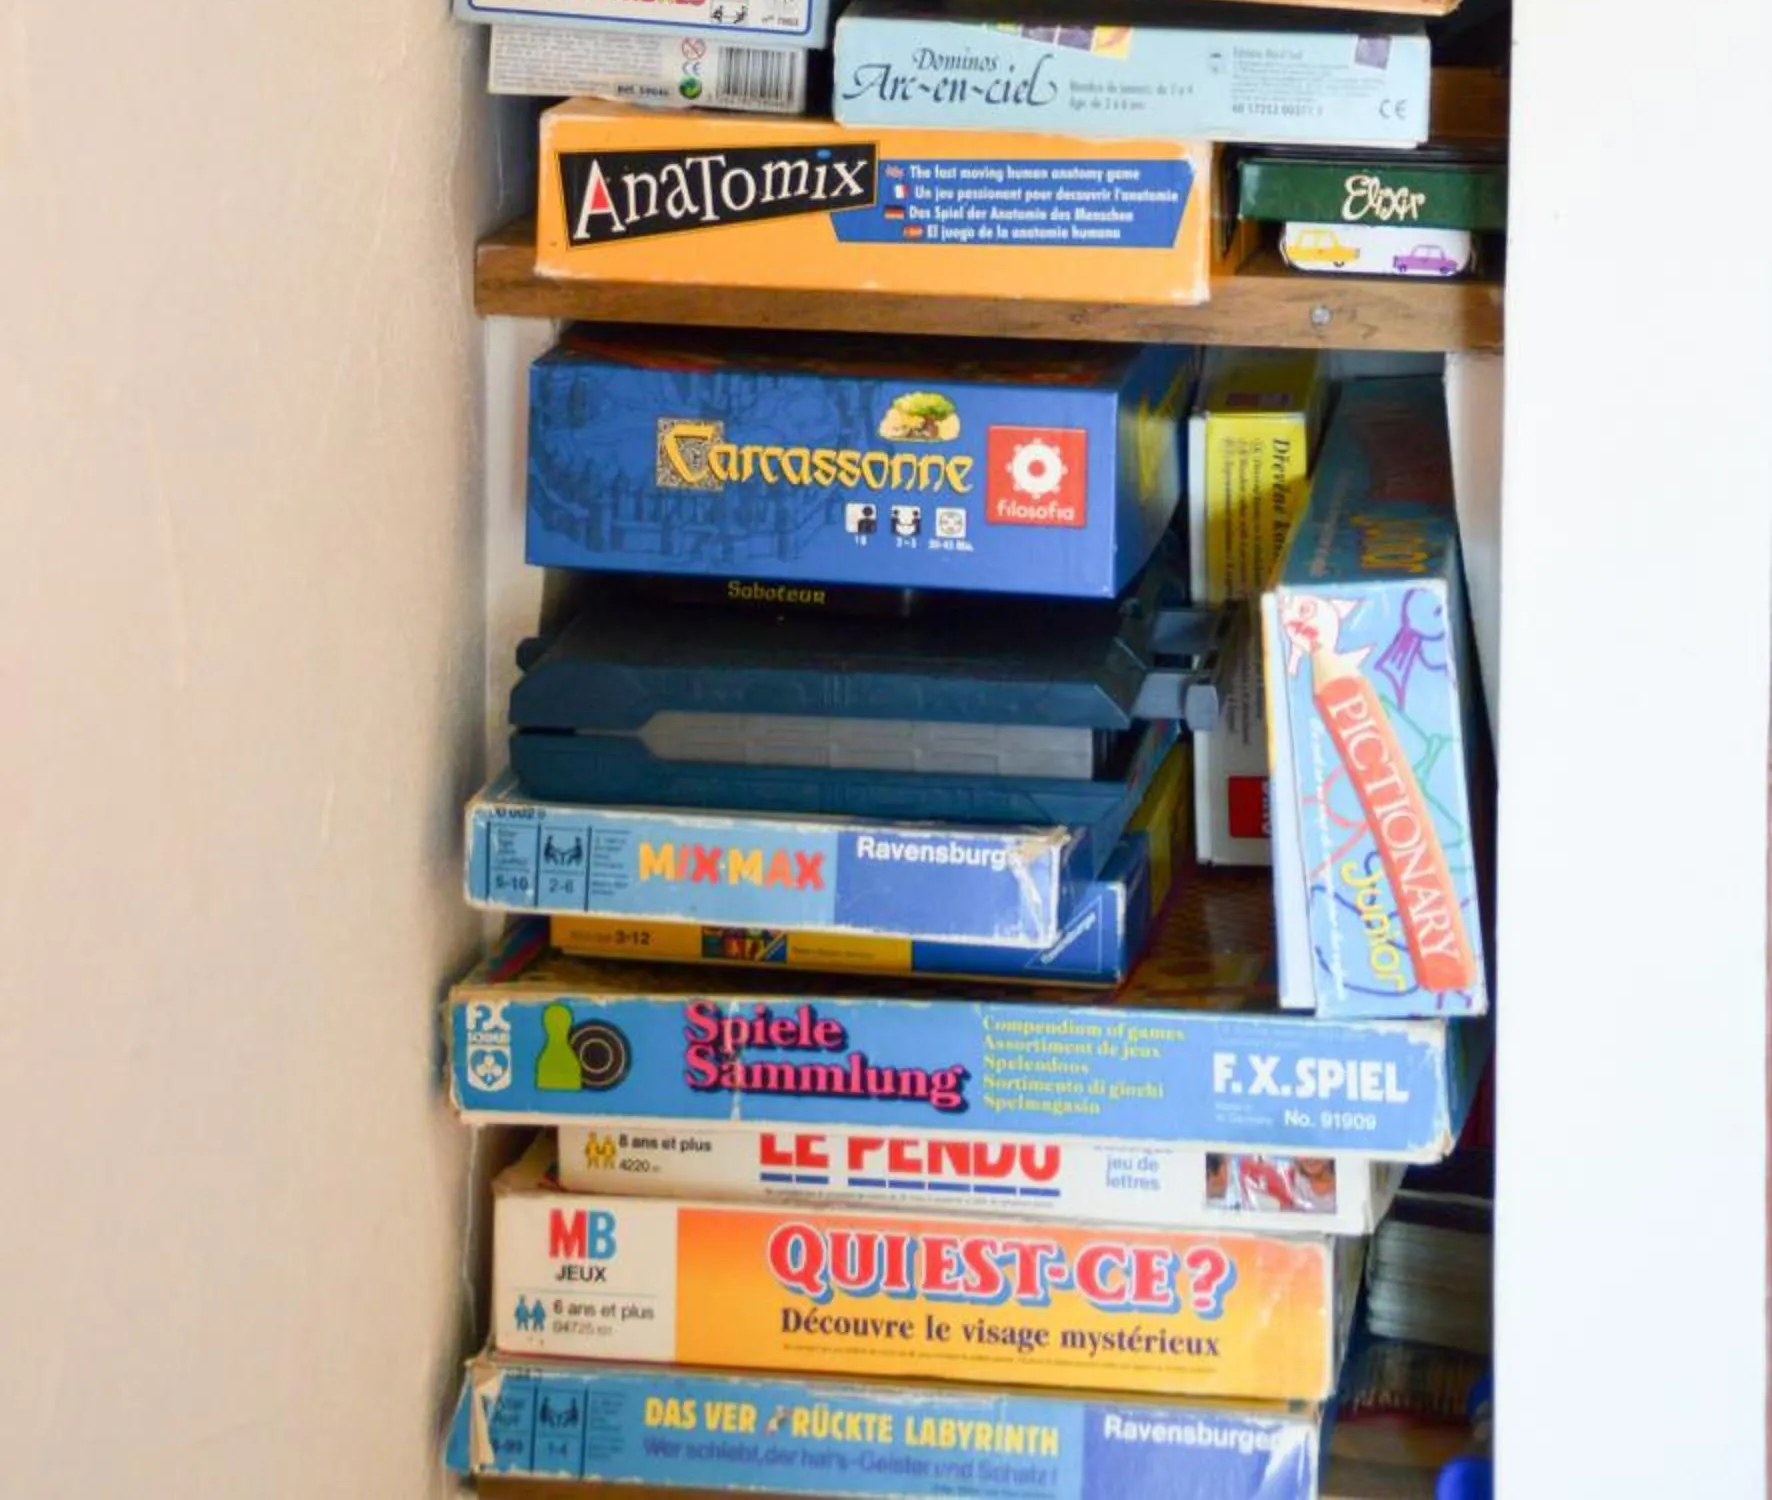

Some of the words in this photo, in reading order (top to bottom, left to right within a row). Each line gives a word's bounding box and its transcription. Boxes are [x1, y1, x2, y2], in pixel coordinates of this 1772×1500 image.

[911, 46, 1000, 73] Dominos
[841, 53, 1058, 107] Arc-en-ciel
[909, 164, 933, 180] The
[934, 164, 958, 180] fast
[959, 165, 1005, 184] moving
[1007, 165, 1048, 181] human
[1050, 167, 1104, 185] anatomy
[1105, 169, 1141, 185] game
[914, 184, 933, 200] Un
[934, 185, 954, 202] jeu
[1024, 188, 1053, 204] pour
[908, 204, 932, 220] Das
[933, 204, 965, 223] Spiel
[966, 205, 988, 221] der
[990, 206, 1049, 222] Anatomie
[1050, 207, 1073, 222] des
[1073, 207, 1135, 223] Menschen
[926, 224, 938, 240] El
[939, 225, 977, 243] juego
[977, 225, 995, 240] de
[995, 225, 1010, 240] la
[1070, 225, 1122, 241] humana
[663, 421, 975, 493] Carcassonne
[995, 498, 1076, 522] filosofia
[1328, 694, 1460, 960] PICTIONARY
[684, 1000, 847, 1053] Spiele
[982, 1015, 1102, 1038] Compendium
[1106, 1023, 1125, 1038] of
[1127, 1026, 1186, 1042] games
[983, 1034, 1093, 1055] Assortiment
[1097, 1041, 1119, 1057] de
[1121, 1043, 1162, 1060] jeux
[684, 1042, 970, 1112] Sammlung
[1087, 1079, 1105, 1095] di
[1109, 1081, 1165, 1100] giochi
[1283, 1108, 1314, 1129] No.
[1320, 1110, 1377, 1131] 91909
[618, 1133, 628, 1150] 8
[630, 1136, 659, 1151] ans
[660, 1135, 678, 1151] et
[679, 1136, 712, 1153] plus
[619, 1159, 650, 1173] 4220
[1105, 1156, 1134, 1176] jeu
[1136, 1156, 1159, 1173] de
[1105, 1172, 1161, 1192] lettres
[548, 1206, 618, 1261] MB
[767, 1222, 912, 1298] QUI
[555, 1263, 608, 1283] JEUX
[552, 1299, 563, 1315] 6
[566, 1302, 598, 1318] ans
[599, 1302, 617, 1319] et
[619, 1302, 656, 1322] plus
[780, 1305, 915, 1341] Découvre
[925, 1313, 953, 1341] le
[962, 1317, 1051, 1353] visage
[1059, 1322, 1222, 1359] mystérieux
[644, 1396, 698, 1430] DAS
[903, 1414, 1059, 1458] LABYRINTH
